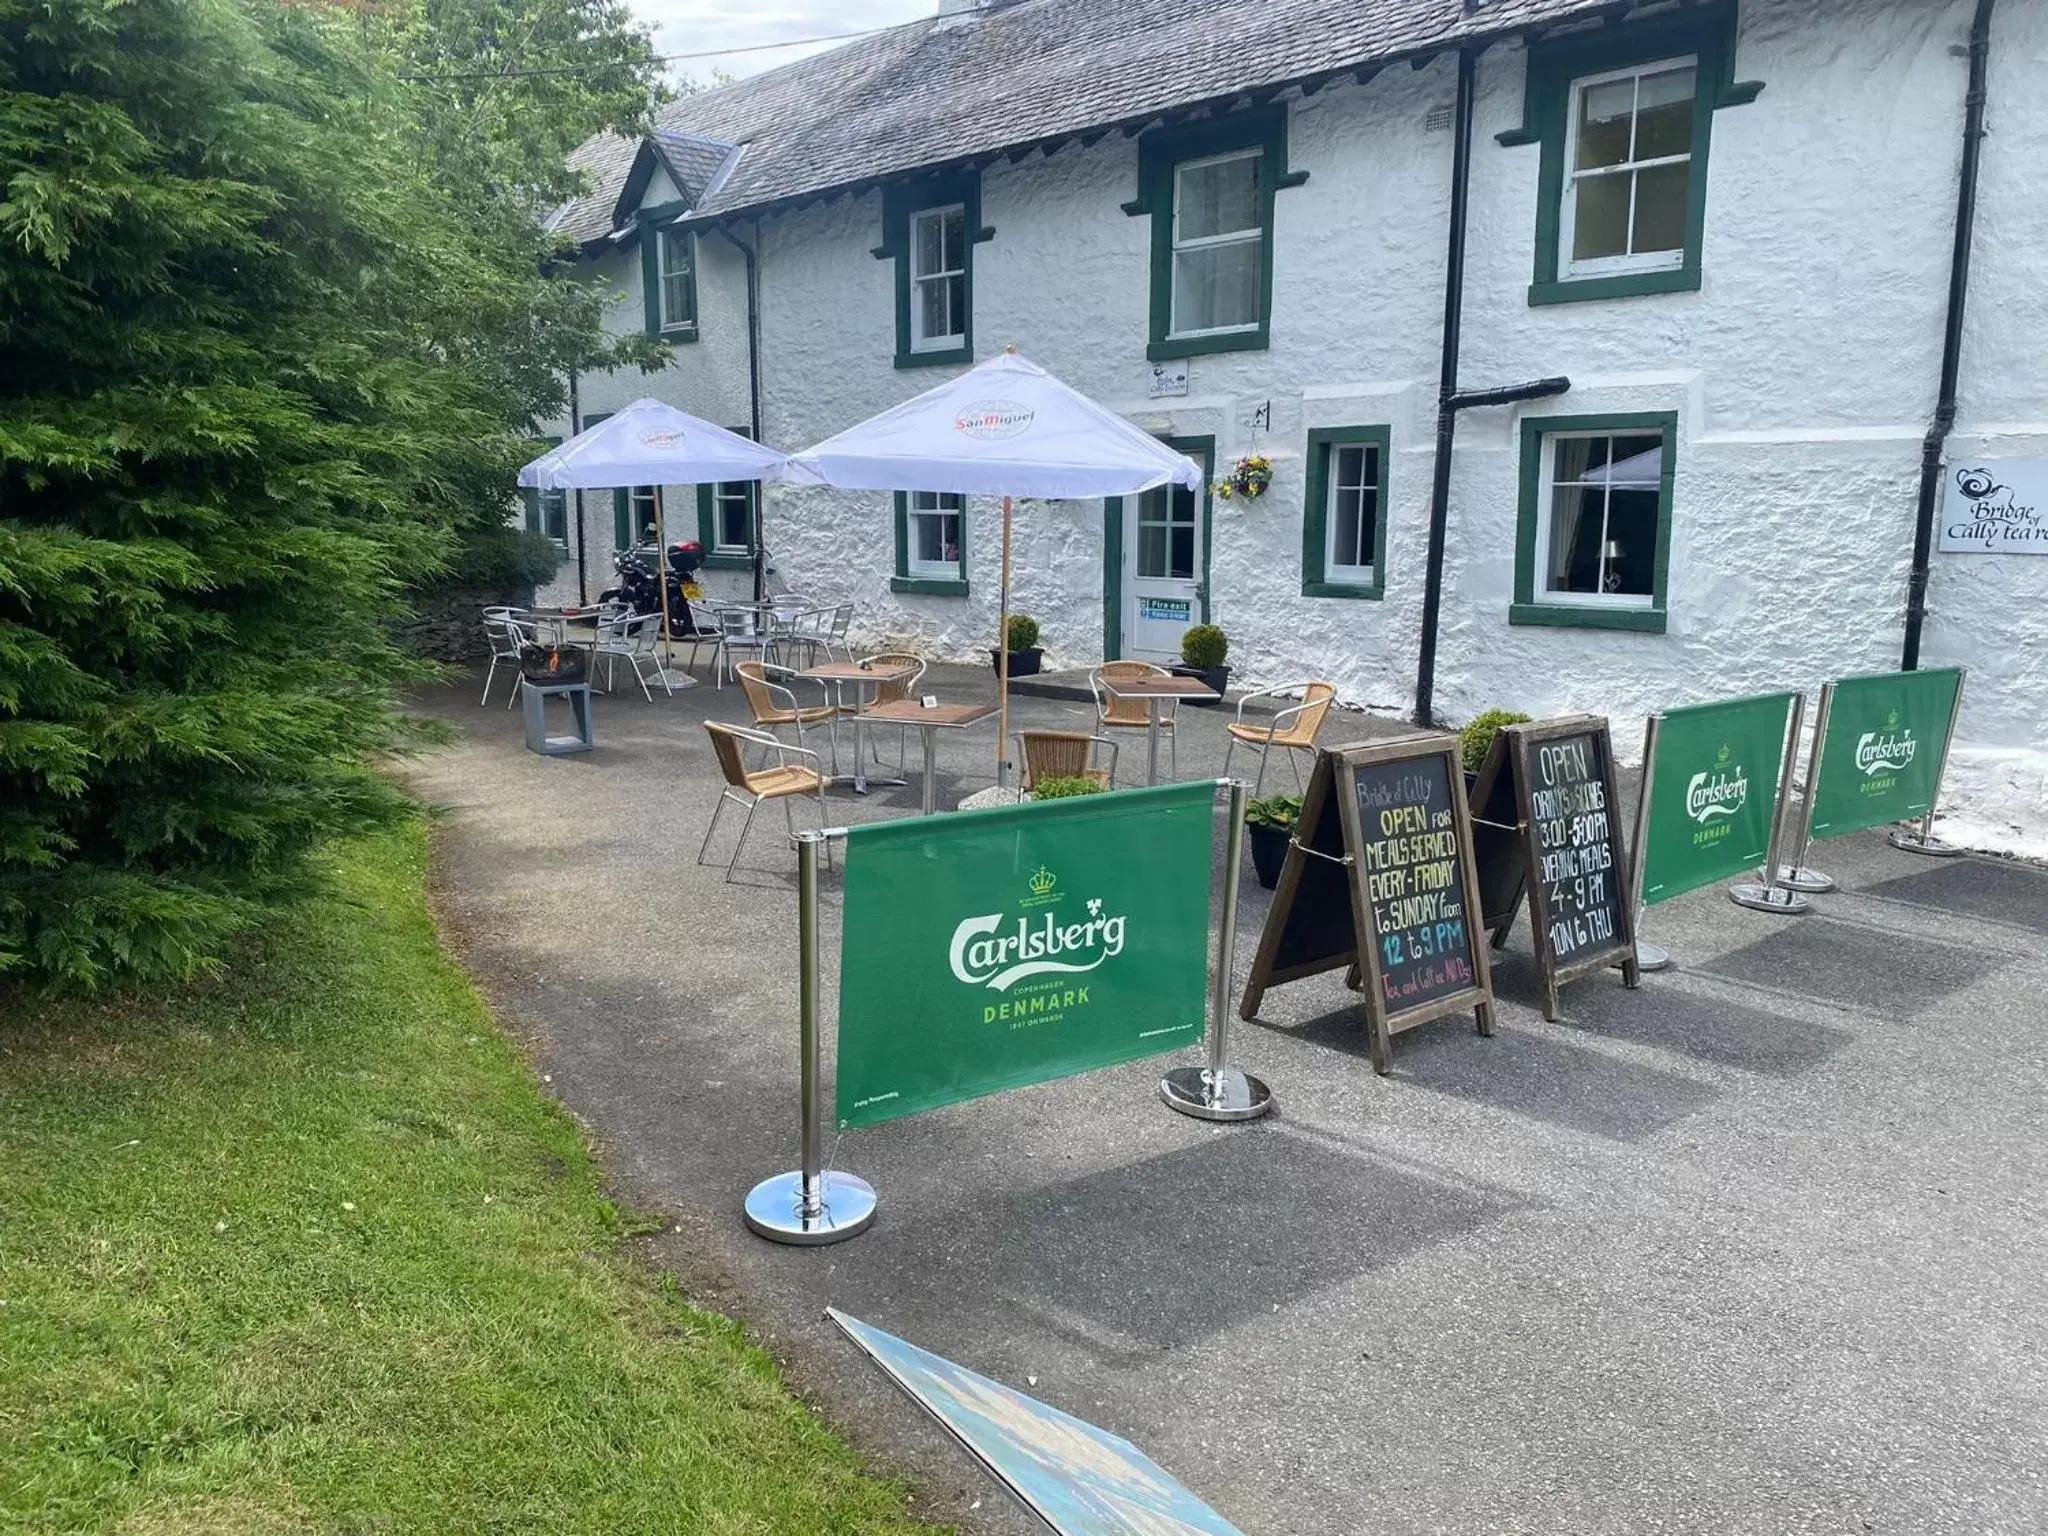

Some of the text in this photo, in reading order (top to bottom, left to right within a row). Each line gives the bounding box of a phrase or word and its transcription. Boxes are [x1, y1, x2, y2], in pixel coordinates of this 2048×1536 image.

[1970, 501, 2044, 526] Bridge of
[1948, 520, 1998, 547] Cally
[2003, 525, 2030, 540] tea
[1540, 742, 1588, 786] OPEN
[1855, 732, 1916, 776] Carlsberg
[1686, 770, 1747, 820] Carlsberg
[1381, 804, 1452, 837] OPEN FOR
[1366, 830, 1456, 870] MEALS SERVED
[1580, 842, 1612, 875] MEALS
[1551, 881, 1565, 912] 4
[1575, 877, 1586, 910] 9
[1588, 873, 1605, 905] PM
[1374, 891, 1462, 934] to SUNDAY from
[1585, 906, 1613, 943] THU
[950, 906, 1127, 986] Carlsberg
[1383, 919, 1465, 966] 12 to 9 PM
[984, 986, 1090, 1024] DENMARK
